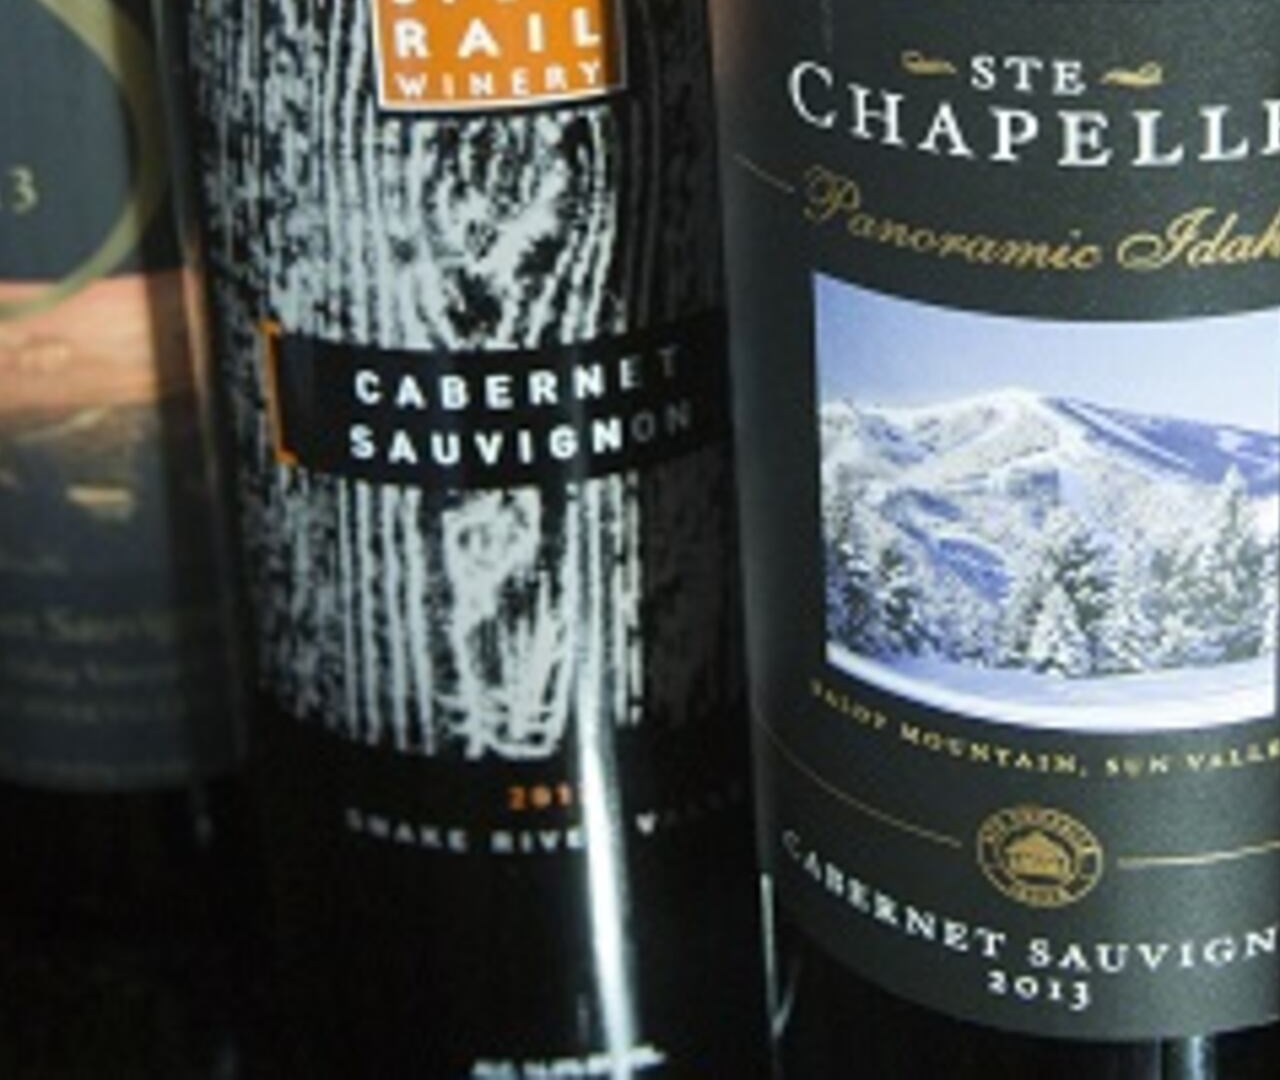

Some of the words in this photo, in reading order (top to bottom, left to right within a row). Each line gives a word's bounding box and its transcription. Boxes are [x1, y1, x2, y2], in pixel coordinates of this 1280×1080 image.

[394, 9, 601, 59] RAIL
[394, 60, 601, 99] WINERY
[969, 55, 1086, 96] STE
[802, 165, 1102, 272] Panoramic
[354, 344, 682, 411] CABERNET
[349, 402, 694, 465] SAUVIGNON
[900, 721, 1087, 778] MOUNTAIN,
[507, 782, 586, 812] 201
[490, 824, 596, 853] RIVE
[782, 829, 1008, 958] CABERNET
[987, 970, 1093, 1010] 2013
